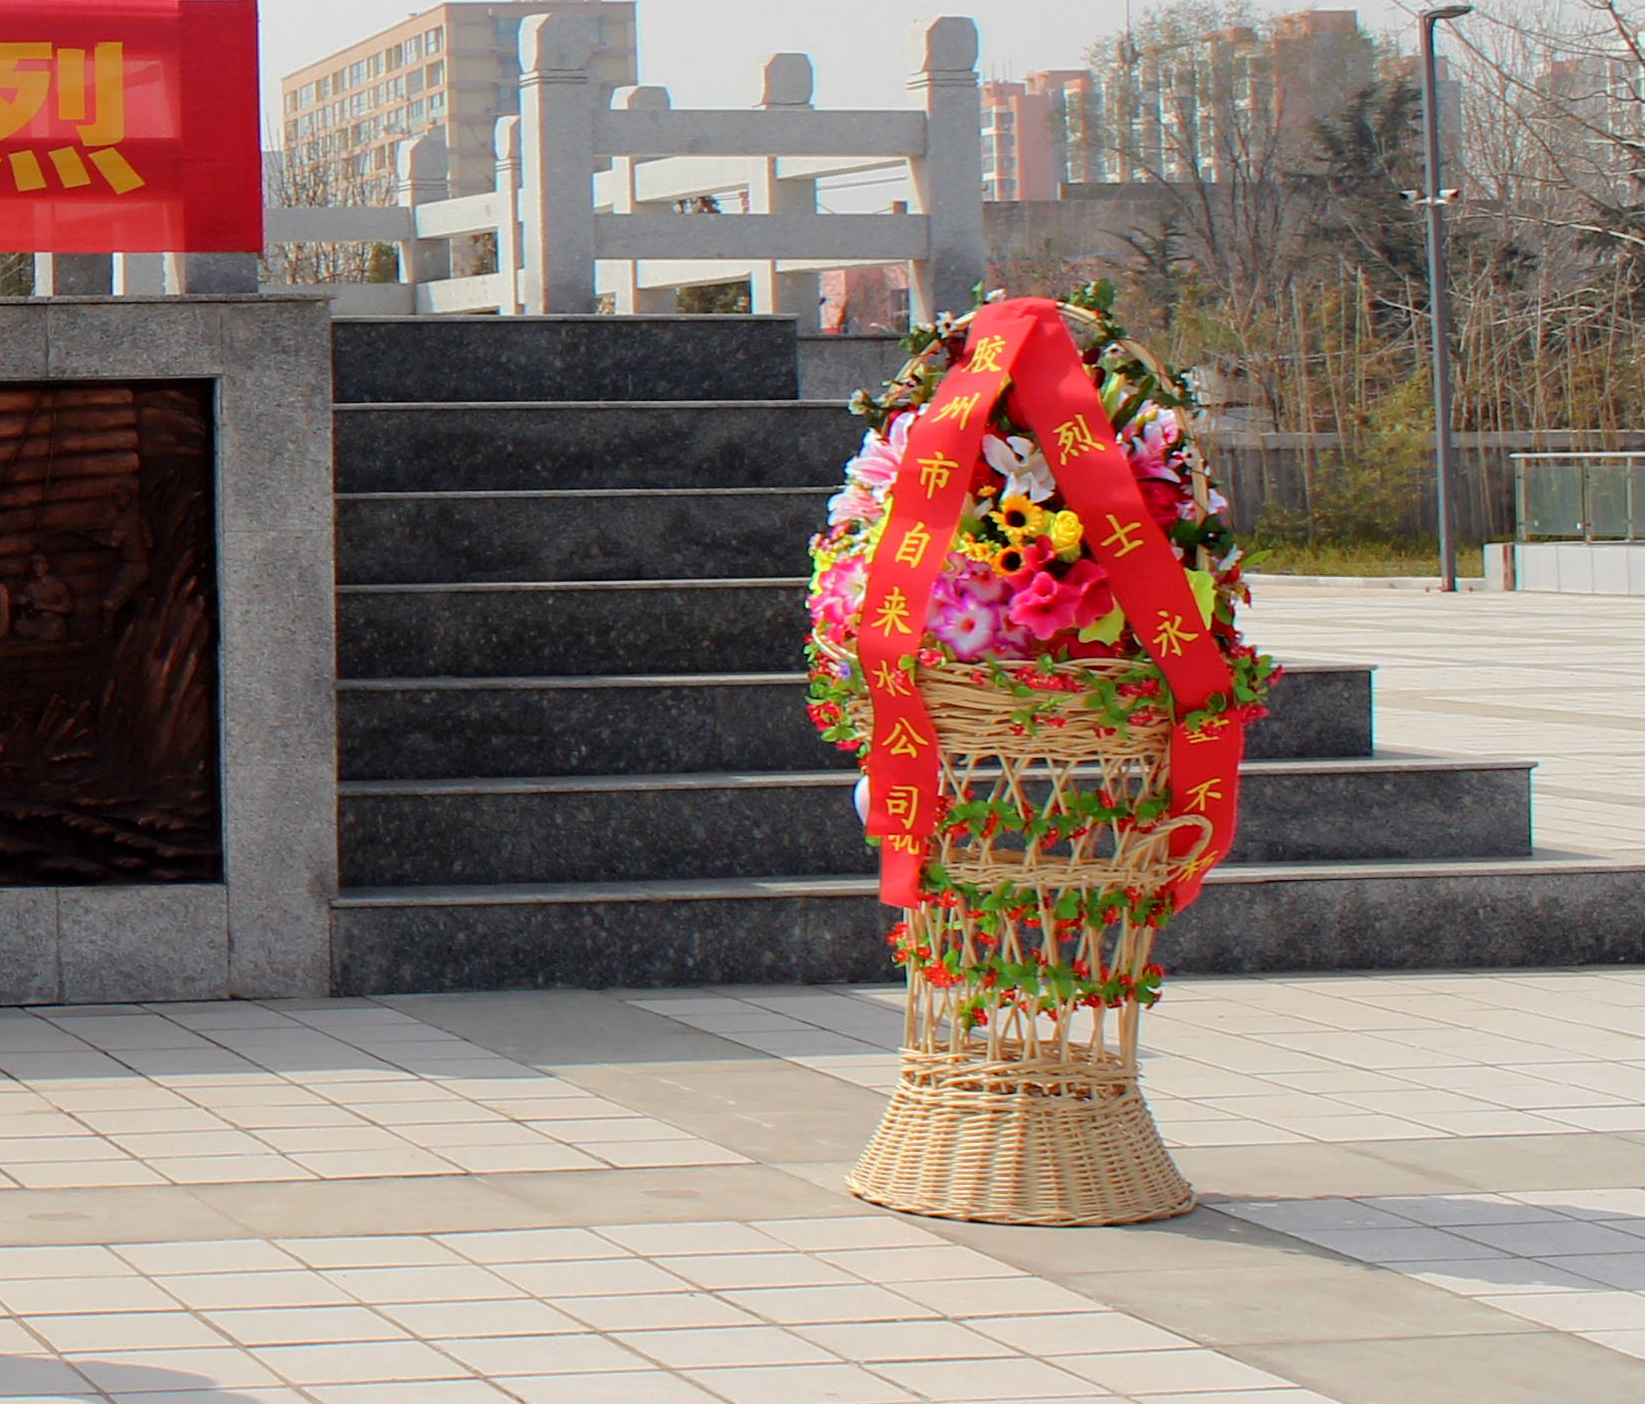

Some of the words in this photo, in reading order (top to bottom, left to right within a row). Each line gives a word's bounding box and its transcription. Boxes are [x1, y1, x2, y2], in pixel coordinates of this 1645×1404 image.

[870, 335, 1006, 830] 胶州市自来水公司
